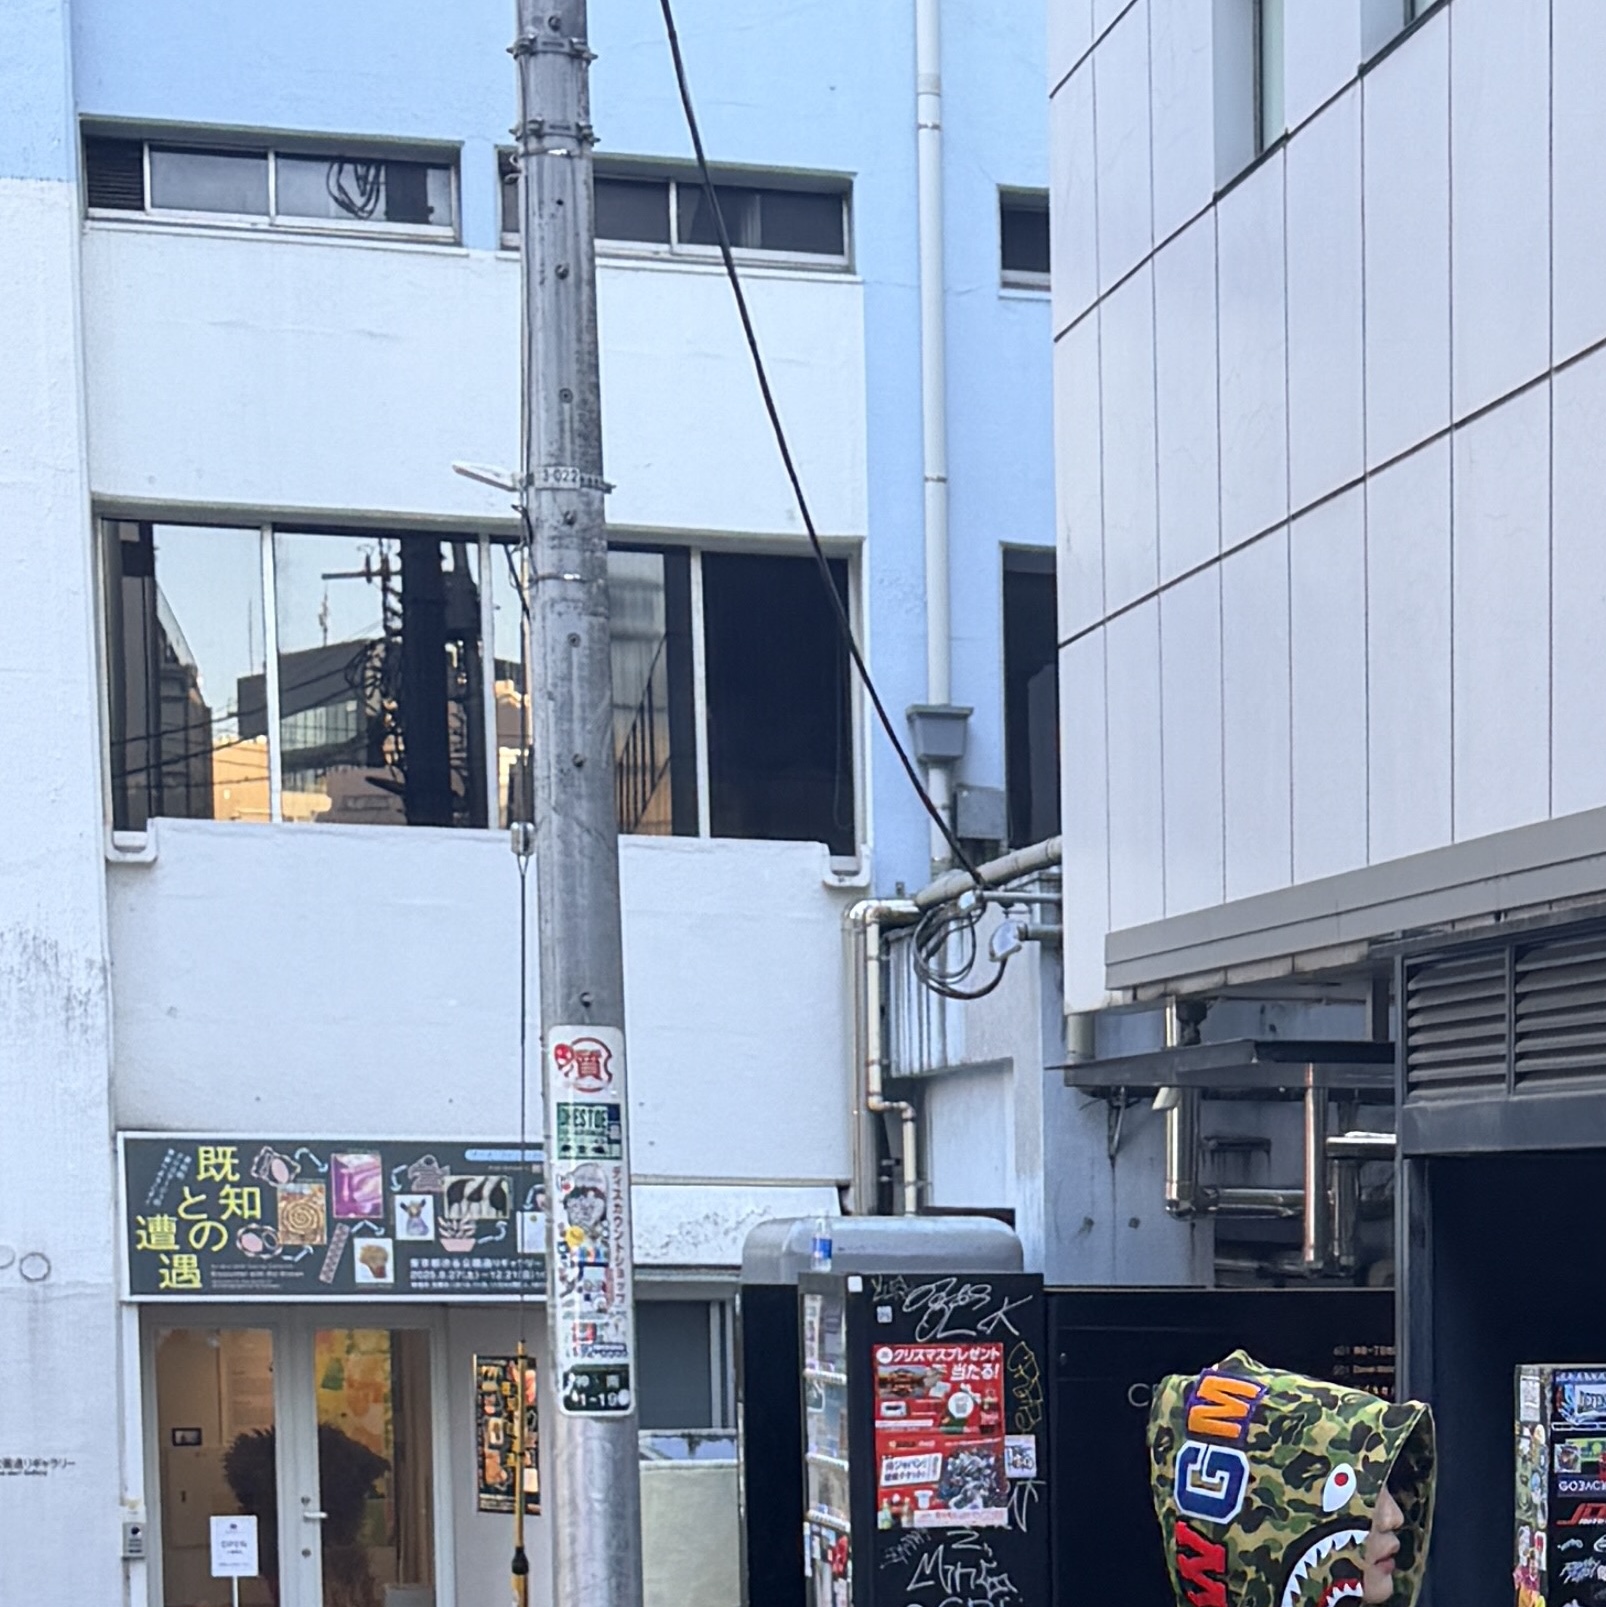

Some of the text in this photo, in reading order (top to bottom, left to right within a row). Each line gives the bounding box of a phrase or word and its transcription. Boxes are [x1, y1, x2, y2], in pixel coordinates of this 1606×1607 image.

[893, 1346, 1001, 1363] クリスマスプレゼント
